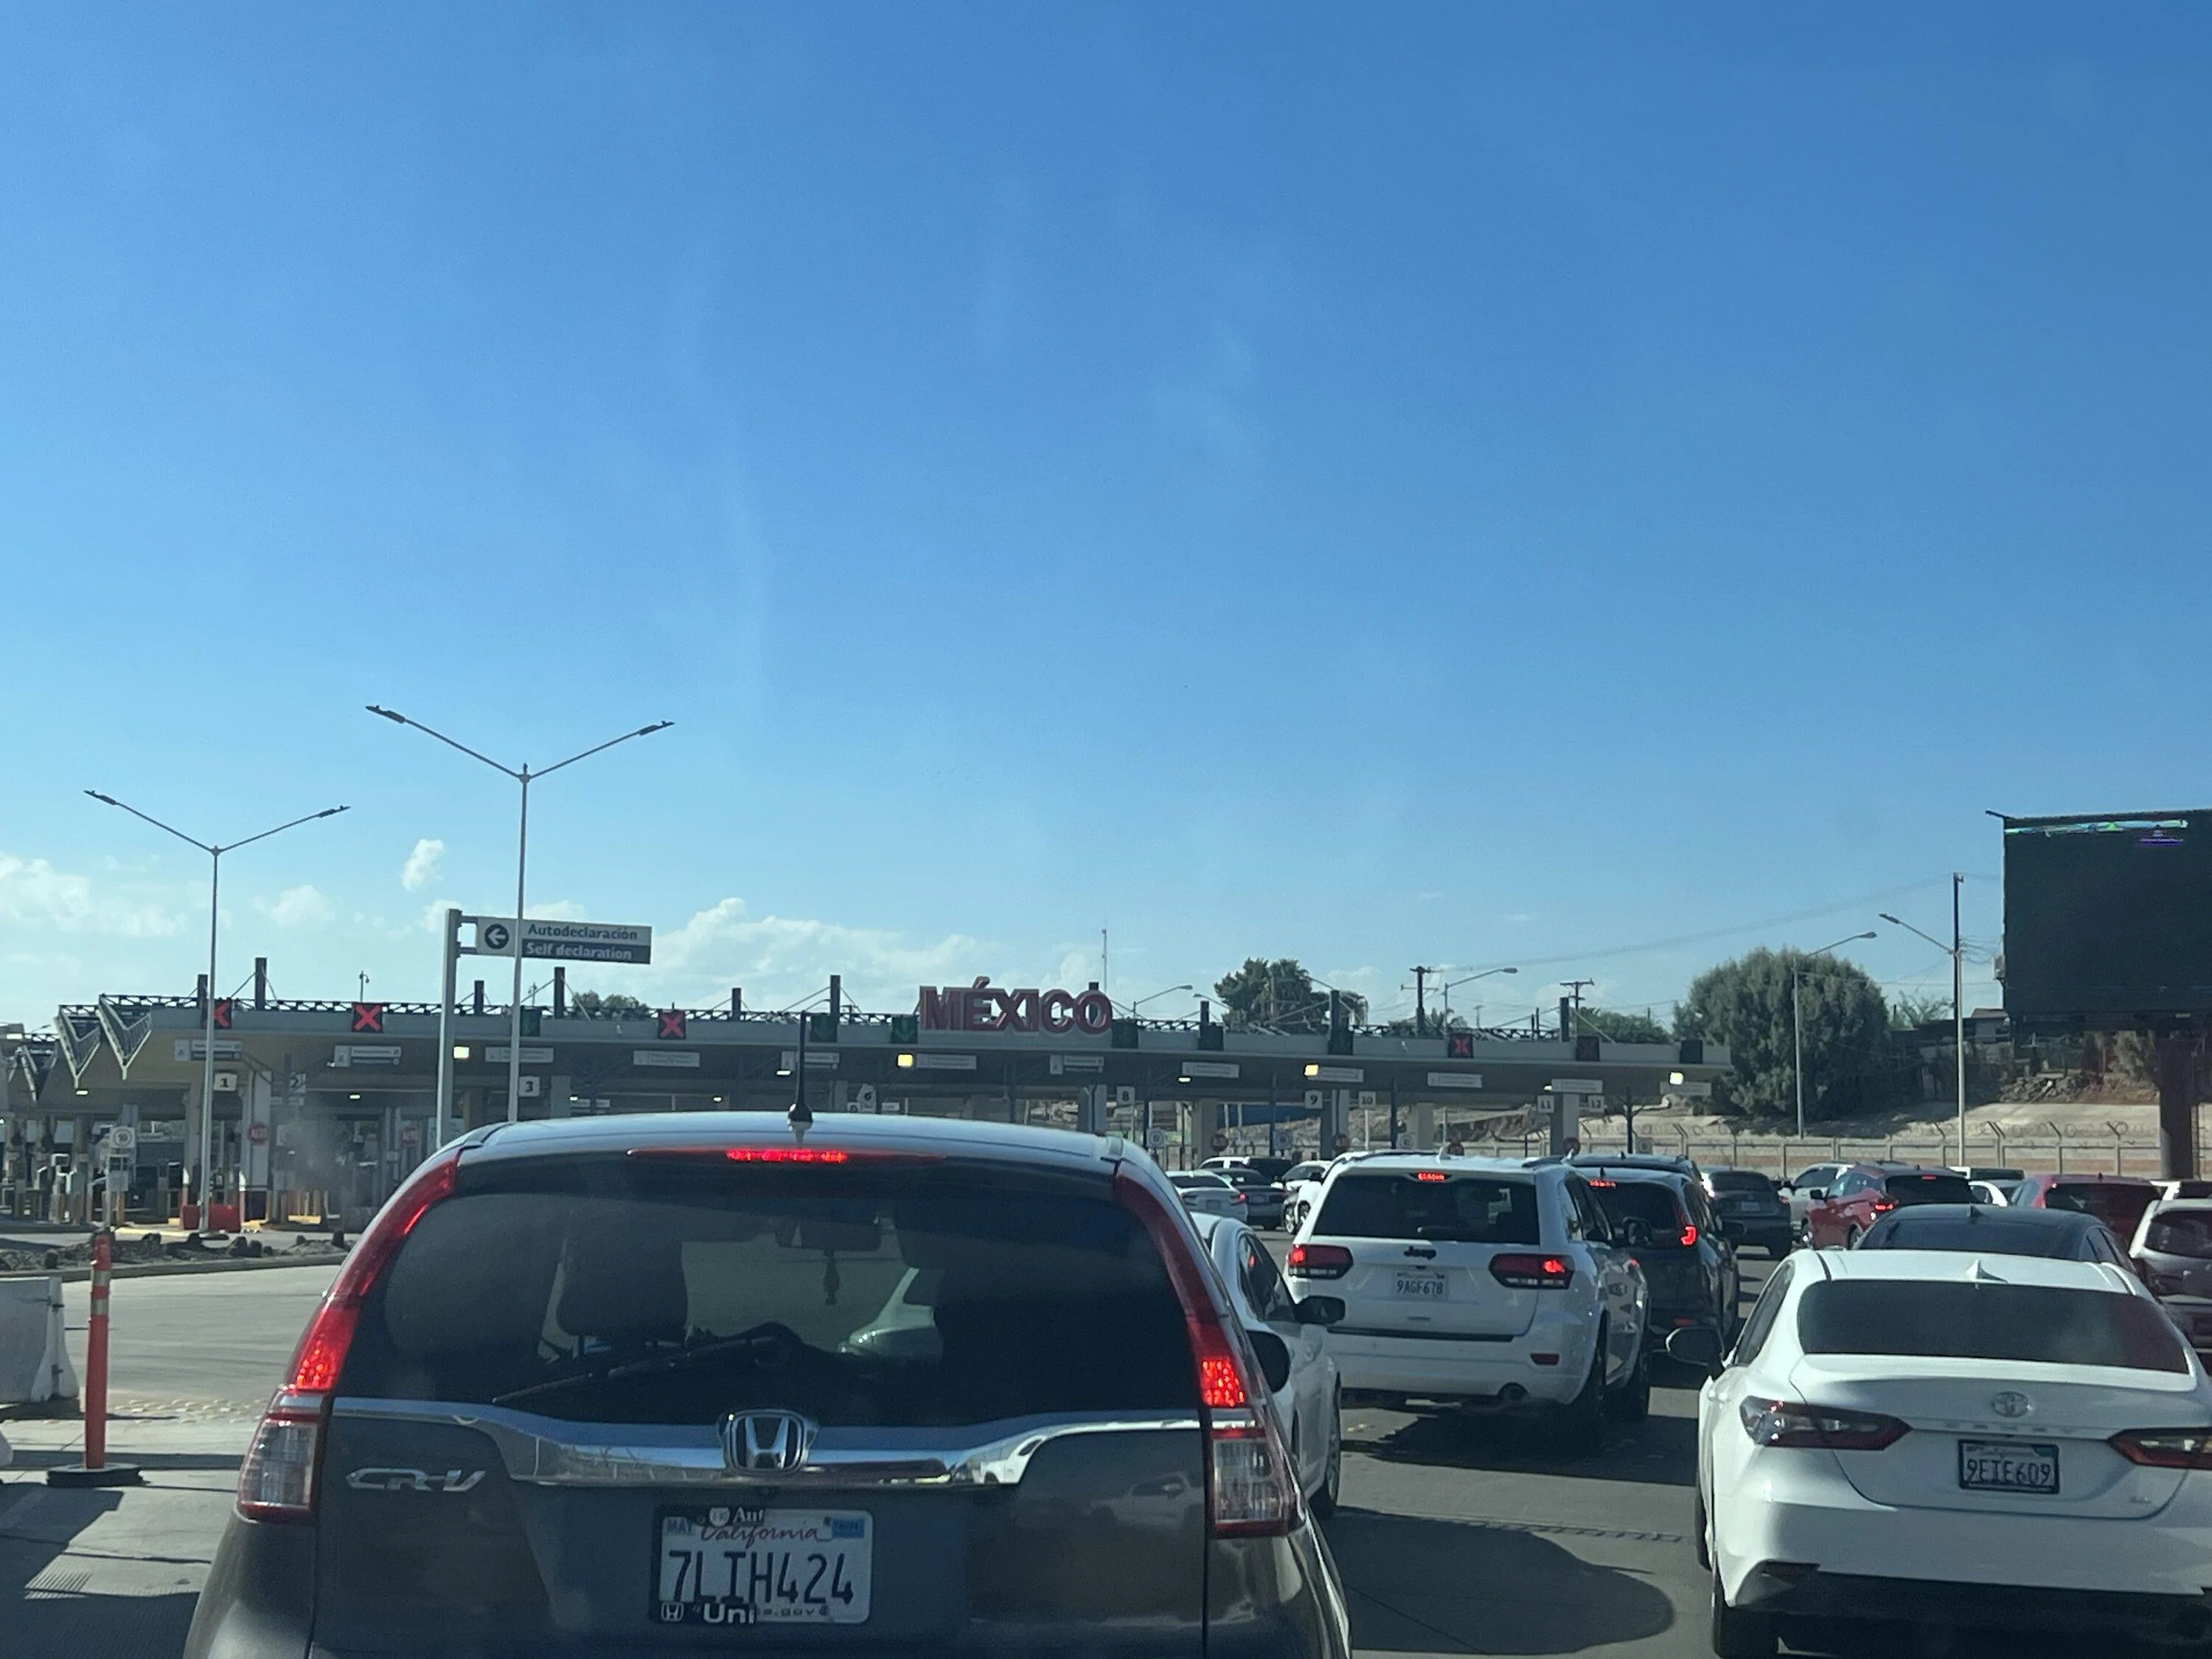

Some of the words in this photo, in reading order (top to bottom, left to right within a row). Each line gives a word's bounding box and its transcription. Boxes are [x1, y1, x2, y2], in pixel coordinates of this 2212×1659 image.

[527, 923, 638, 941] Autodeclaración
[526, 942, 552, 956] Self
[555, 943, 633, 961] declaration
[919, 975, 1113, 1034] MÉXICO
[220, 1077, 229, 1088] 1
[525, 1080, 534, 1093] 3
[864, 1091, 874, 1101] 6
[1121, 1090, 1130, 1101] 8
[1310, 1094, 1318, 1105] 9
[345, 1467, 486, 1492] CR-V
[700, 1525, 820, 1549] California
[669, 1550, 855, 1605] 7LIH424
